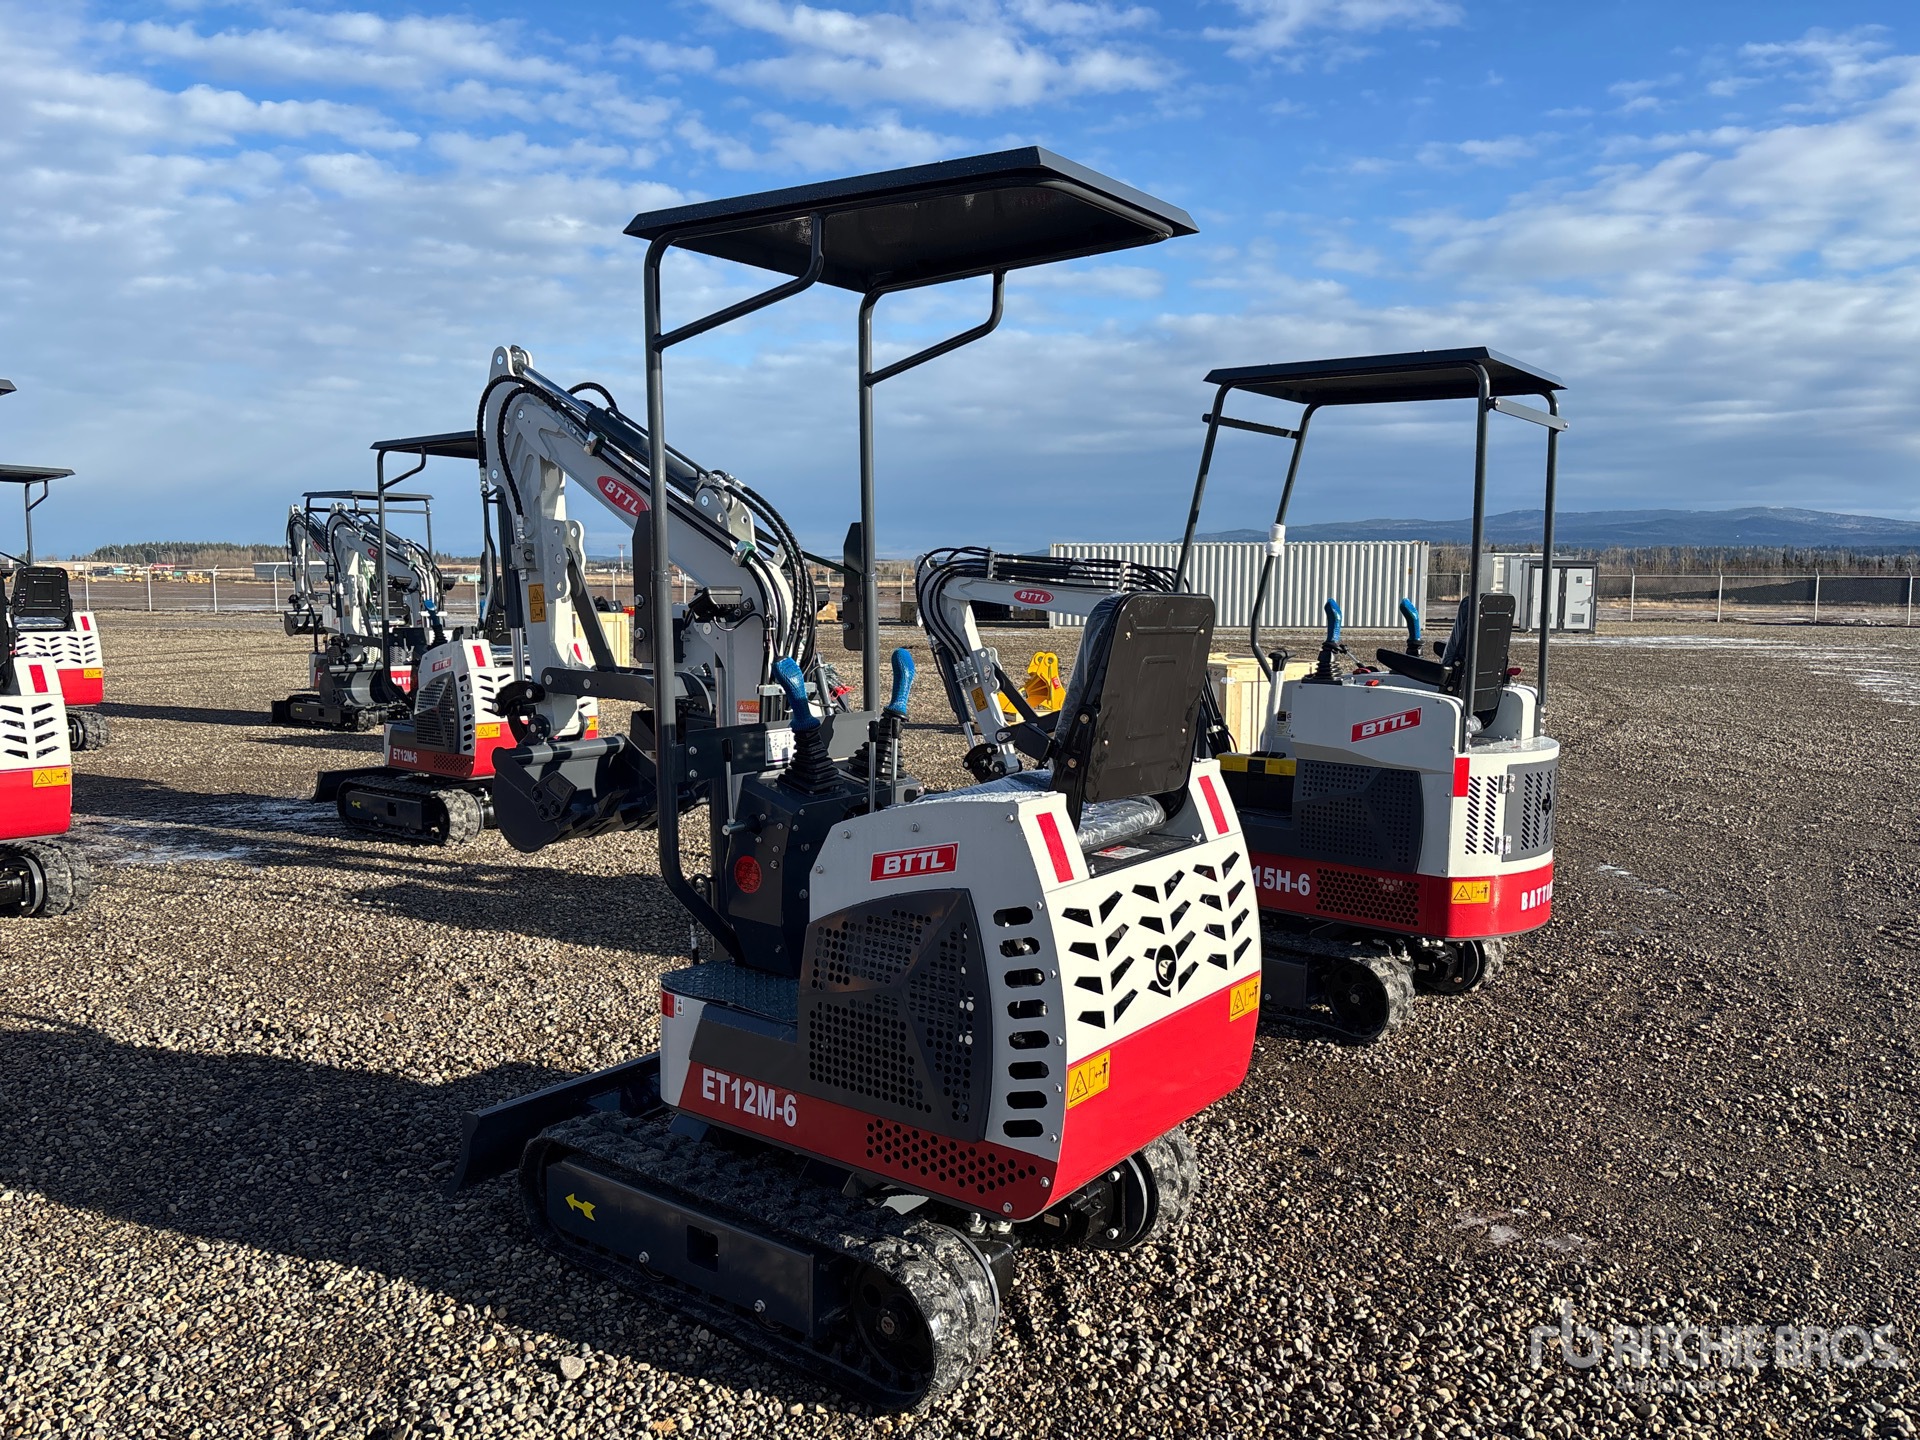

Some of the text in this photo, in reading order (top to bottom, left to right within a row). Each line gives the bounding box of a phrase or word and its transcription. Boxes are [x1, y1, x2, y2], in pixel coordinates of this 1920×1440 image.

[604, 480, 639, 514] BTTL
[1020, 591, 1045, 602] BTTL
[1361, 714, 1412, 737] BTTL
[392, 747, 418, 764] ET12M-6
[882, 850, 946, 875] BTTL
[702, 1067, 797, 1128] ET12M-6
